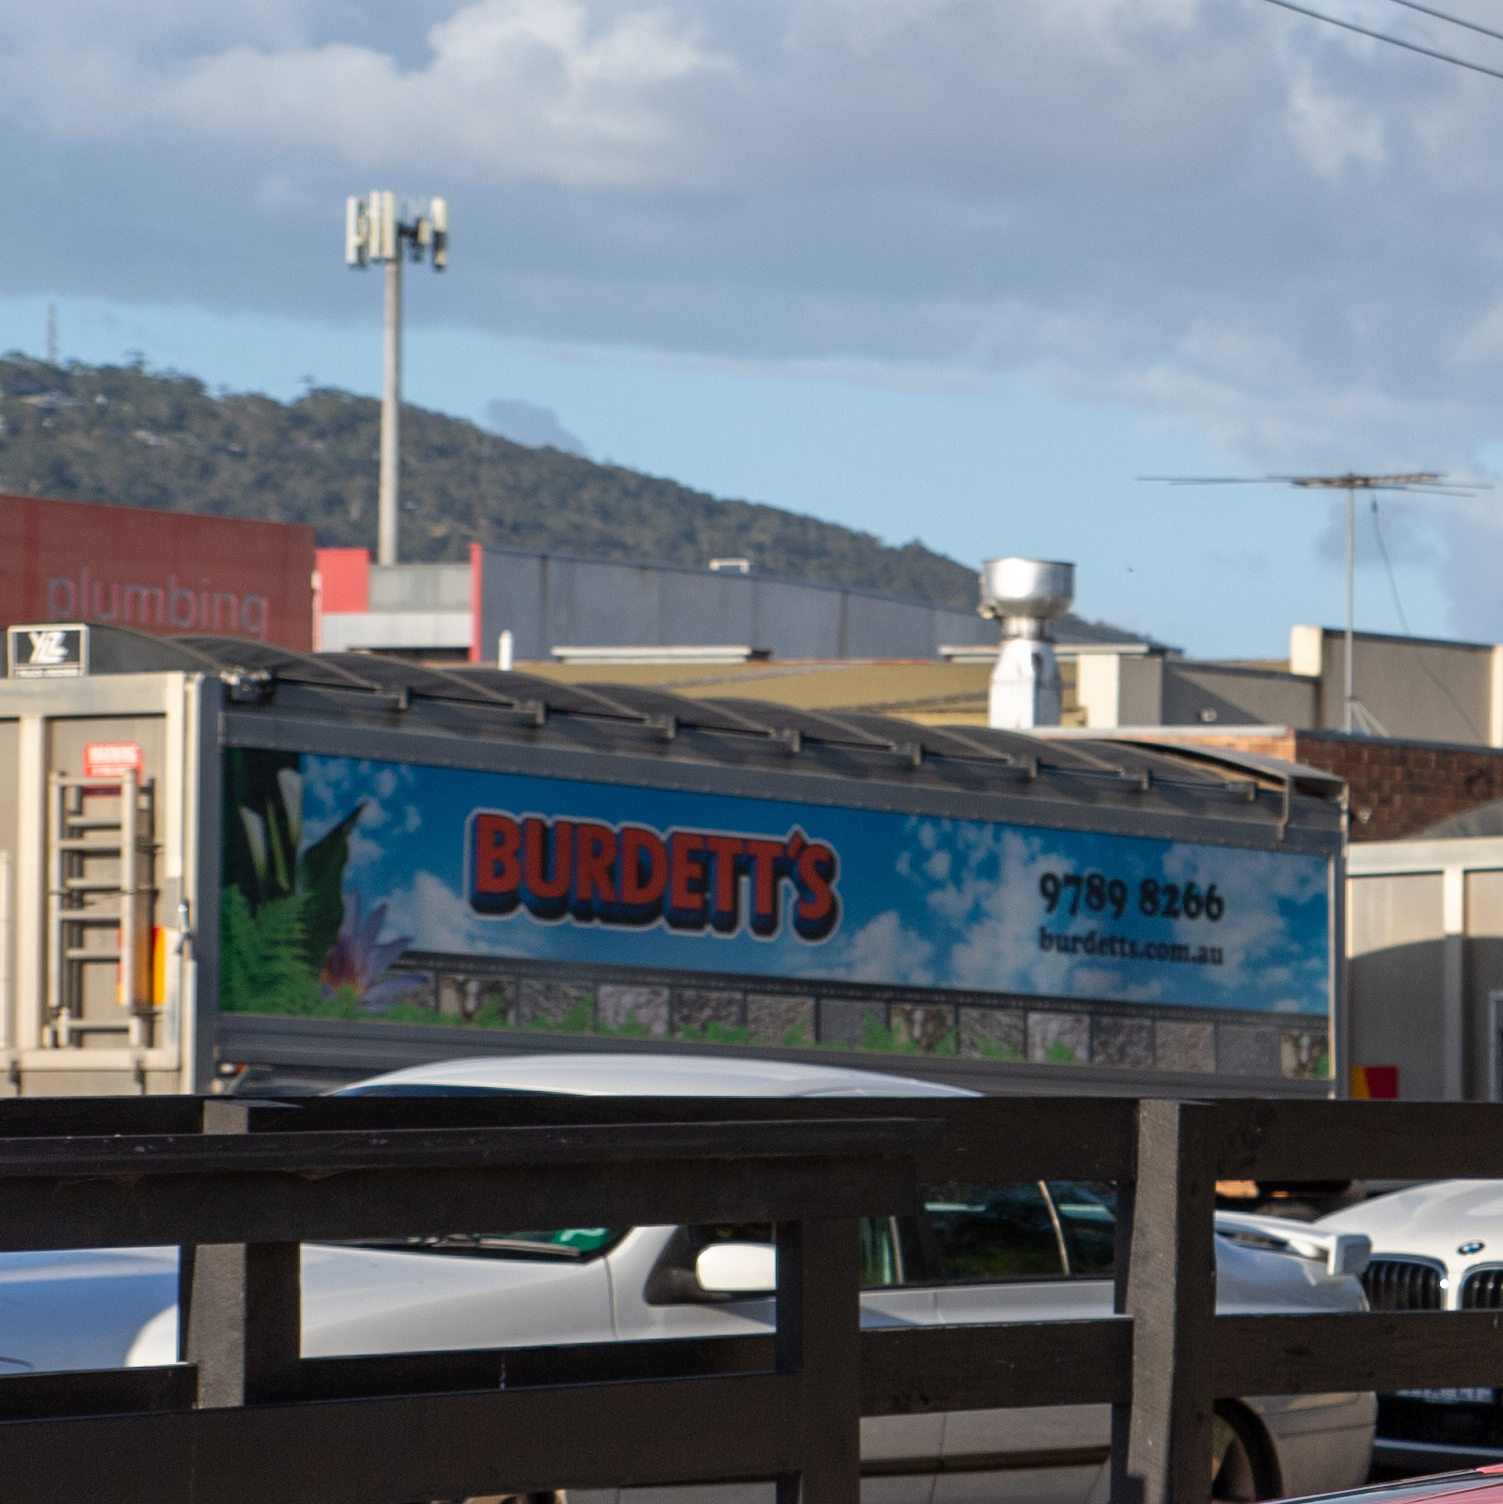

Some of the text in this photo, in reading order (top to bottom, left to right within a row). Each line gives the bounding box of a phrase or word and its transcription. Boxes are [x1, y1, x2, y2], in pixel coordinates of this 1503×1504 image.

[46, 566, 269, 637] plumbing
[471, 811, 837, 934] BURDETT'S
[1040, 872, 1224, 922] 9789 8266
[1040, 926, 1224, 966] burdetts.com.au
